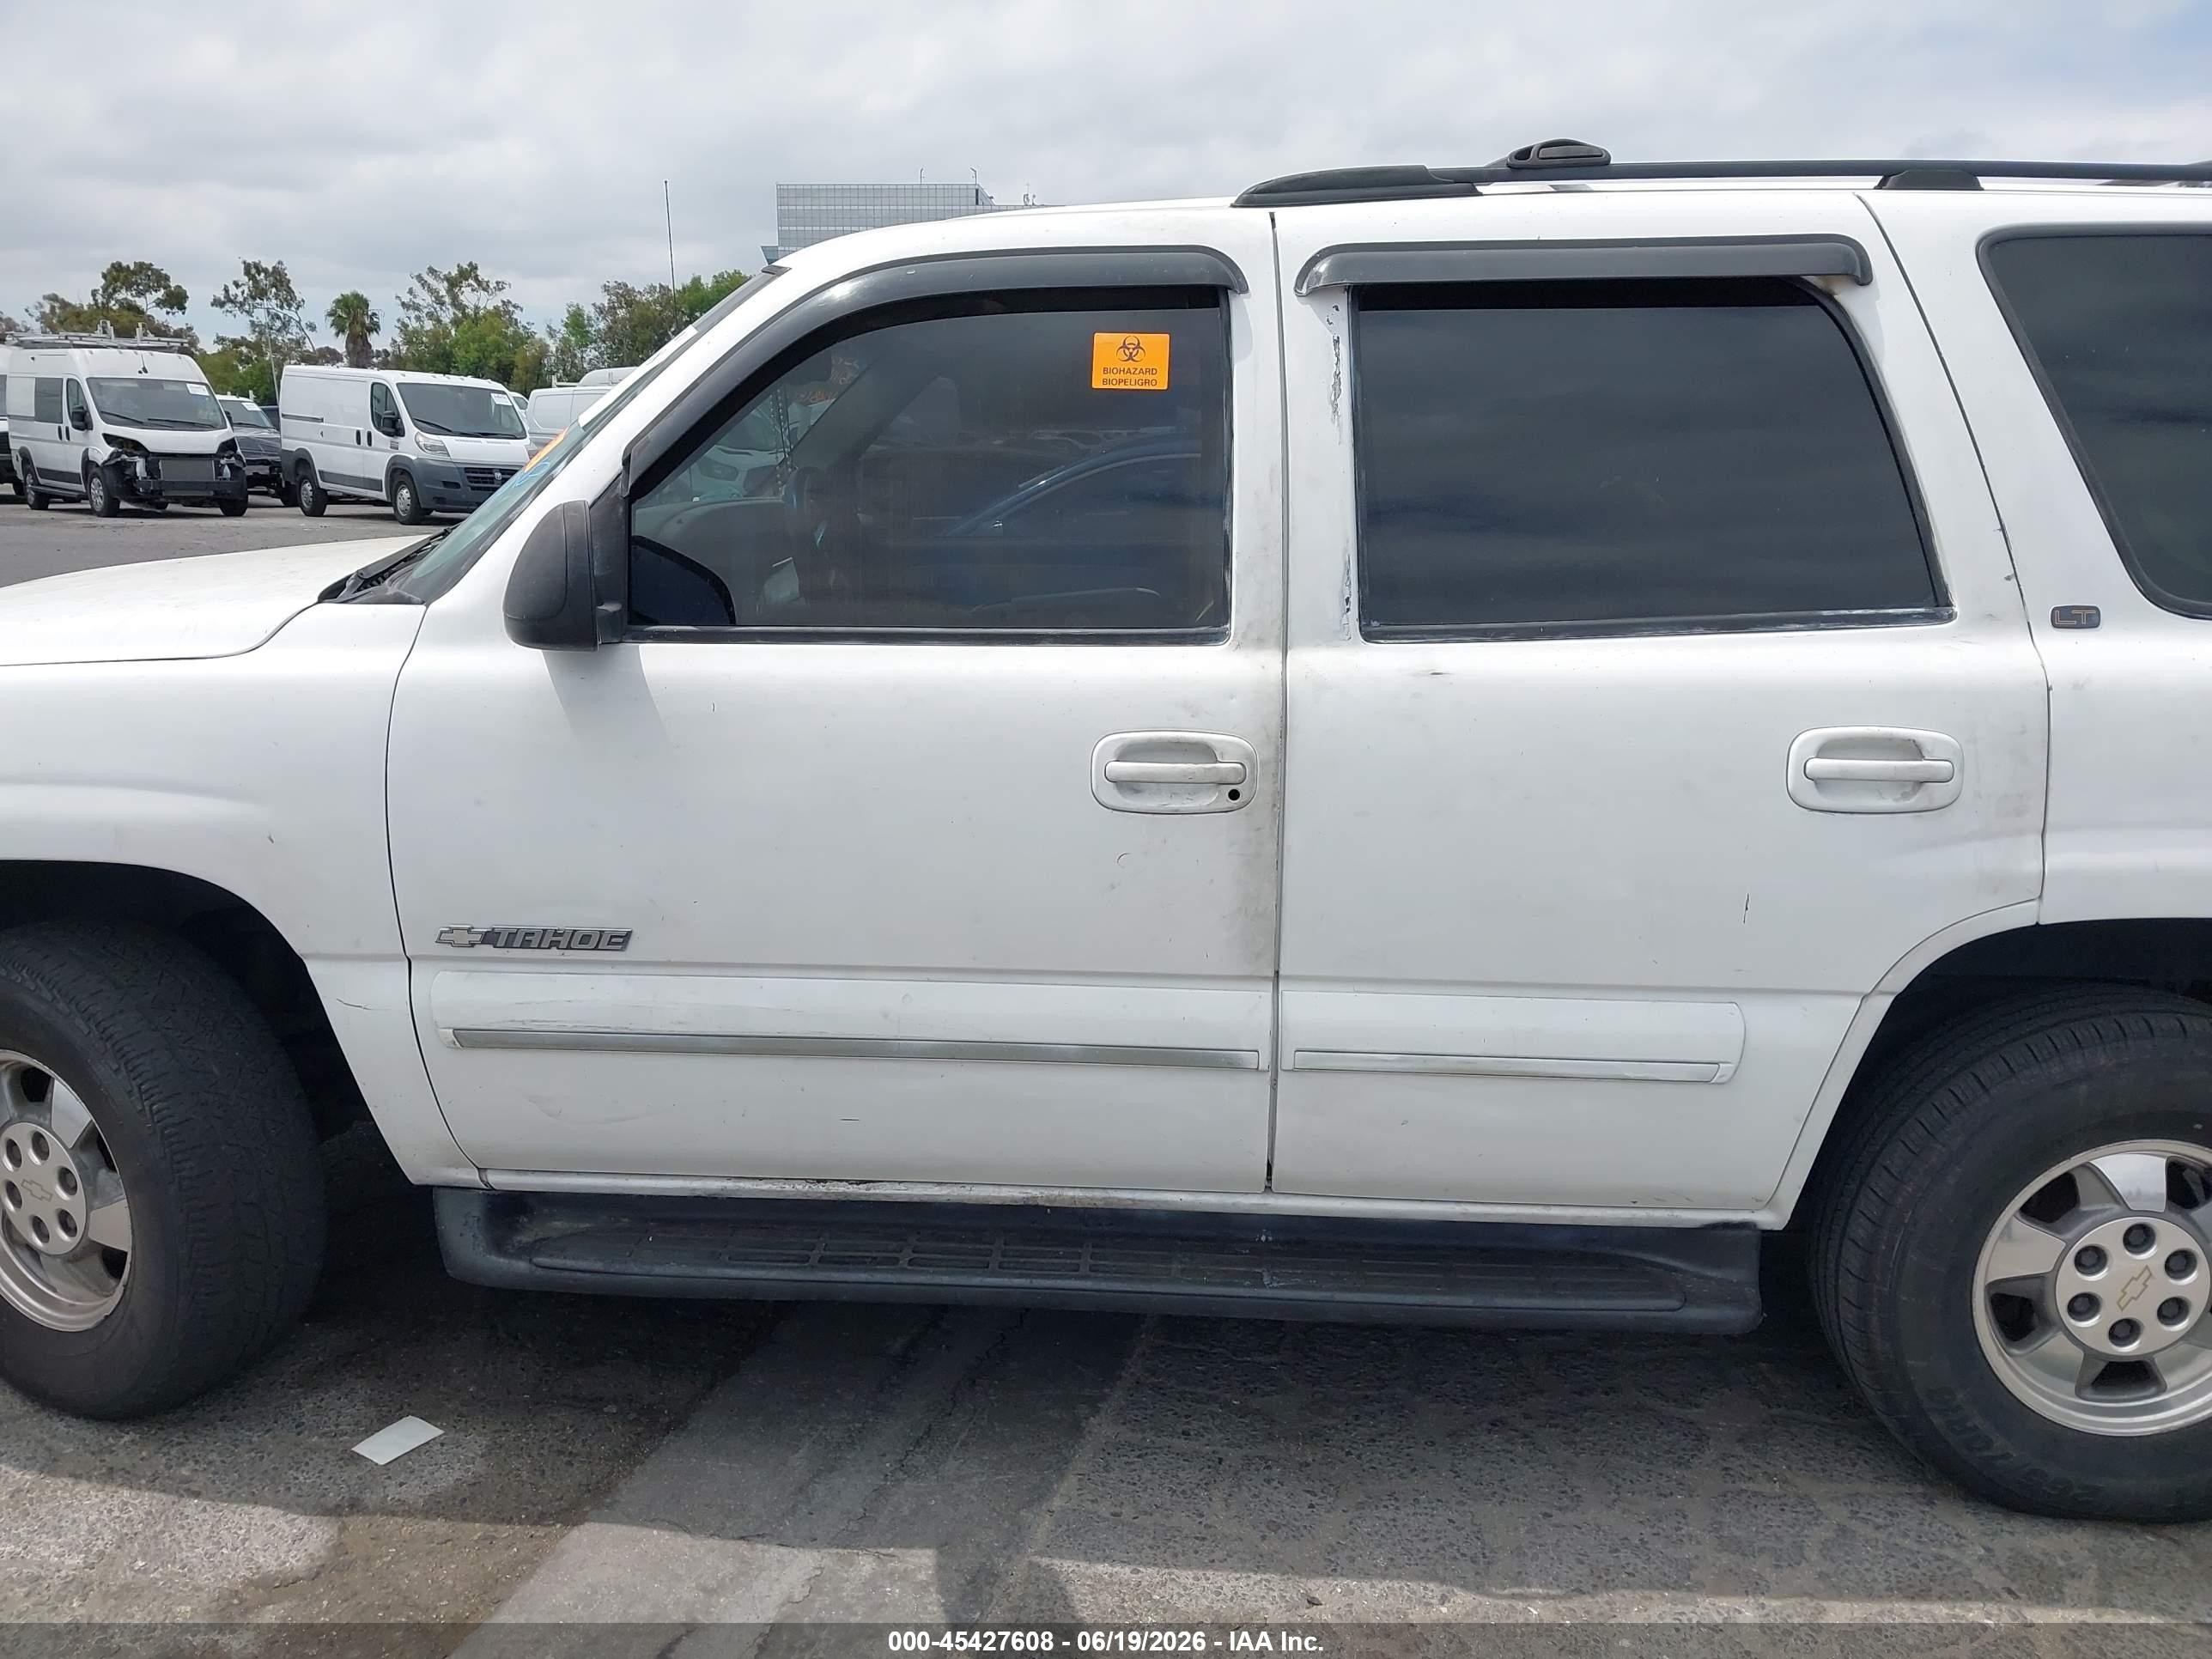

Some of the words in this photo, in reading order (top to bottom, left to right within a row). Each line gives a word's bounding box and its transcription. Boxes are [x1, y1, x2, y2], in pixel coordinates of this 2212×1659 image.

[1103, 367, 1158, 375] BIOHAZARD
[1102, 378, 1158, 386] BIOPELIGRO
[2055, 610, 2096, 624] LT
[493, 928, 628, 951] TAHOE
